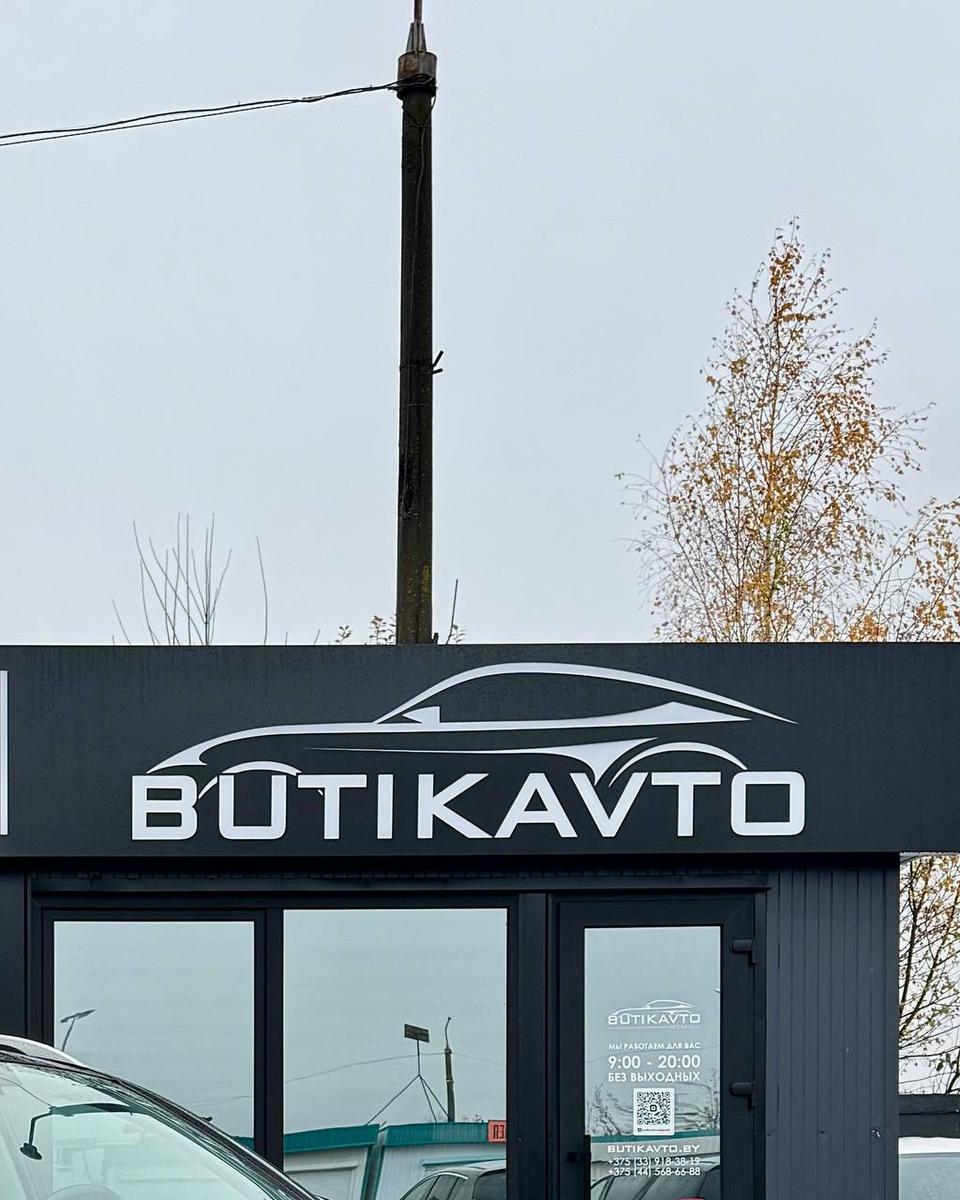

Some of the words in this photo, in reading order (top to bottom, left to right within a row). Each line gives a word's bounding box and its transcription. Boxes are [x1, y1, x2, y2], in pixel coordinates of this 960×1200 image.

[132, 770, 806, 841] BUTIKAVTO
[608, 1013, 701, 1024] BUTIKAVTO
[608, 1042, 622, 1050] МЫ
[623, 1042, 664, 1050] РАБОТАЕМ
[666, 1042, 683, 1050] ДЛЯ
[684, 1041, 701, 1050] ВАС
[608, 1055, 641, 1069] 9:00
[658, 1054, 701, 1069] 20:00
[608, 1072, 627, 1082] БЕЗ
[630, 1071, 701, 1083] ВЫХОДНЫХ
[607, 1144, 701, 1153] BUTIKAVTO.BY
[609, 1157, 631, 1166] +375
[633, 1157, 652, 1168] (33)
[654, 1156, 701, 1166] 918-38-19
[609, 1167, 631, 1176] +375
[633, 1166, 652, 1178] (44)
[654, 1167, 701, 1176] 568-66-88
